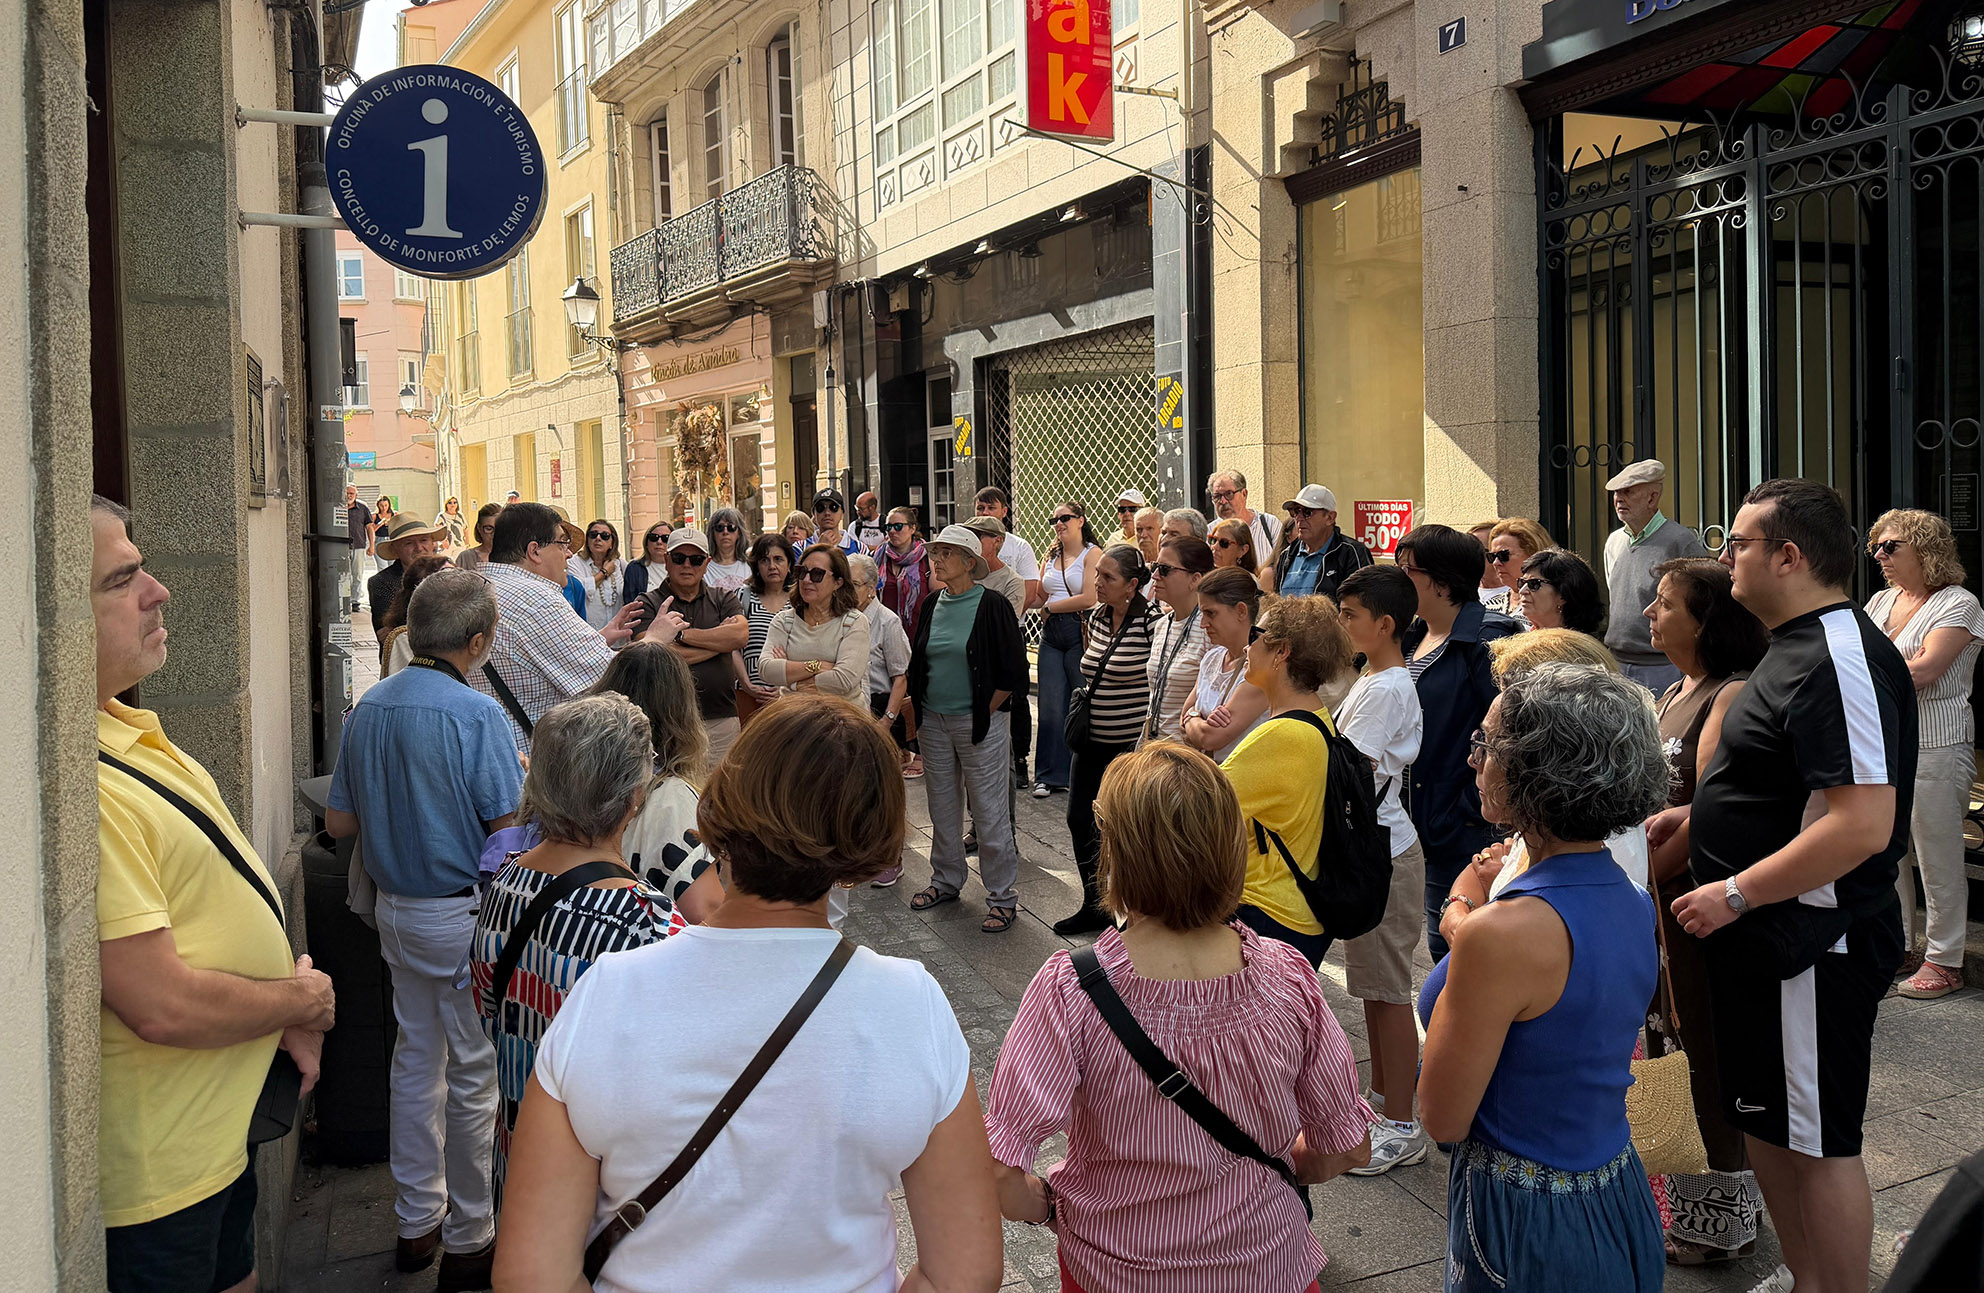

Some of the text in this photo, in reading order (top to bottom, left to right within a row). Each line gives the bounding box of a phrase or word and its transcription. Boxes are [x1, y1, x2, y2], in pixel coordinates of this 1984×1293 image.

[1445, 22, 1459, 47] 7
[337, 74, 535, 176] OFICINA DE INFORMACIÓN E TURISMO
[337, 168, 531, 264] CONCELLO DE MONFORTE DE LEMOS
[1158, 376, 1171, 394] FOTO
[1157, 380, 1184, 429] ARCADIO
[1358, 502, 1408, 511] ÚLTIMOS DÍAS
[1366, 512, 1400, 525] TODO
